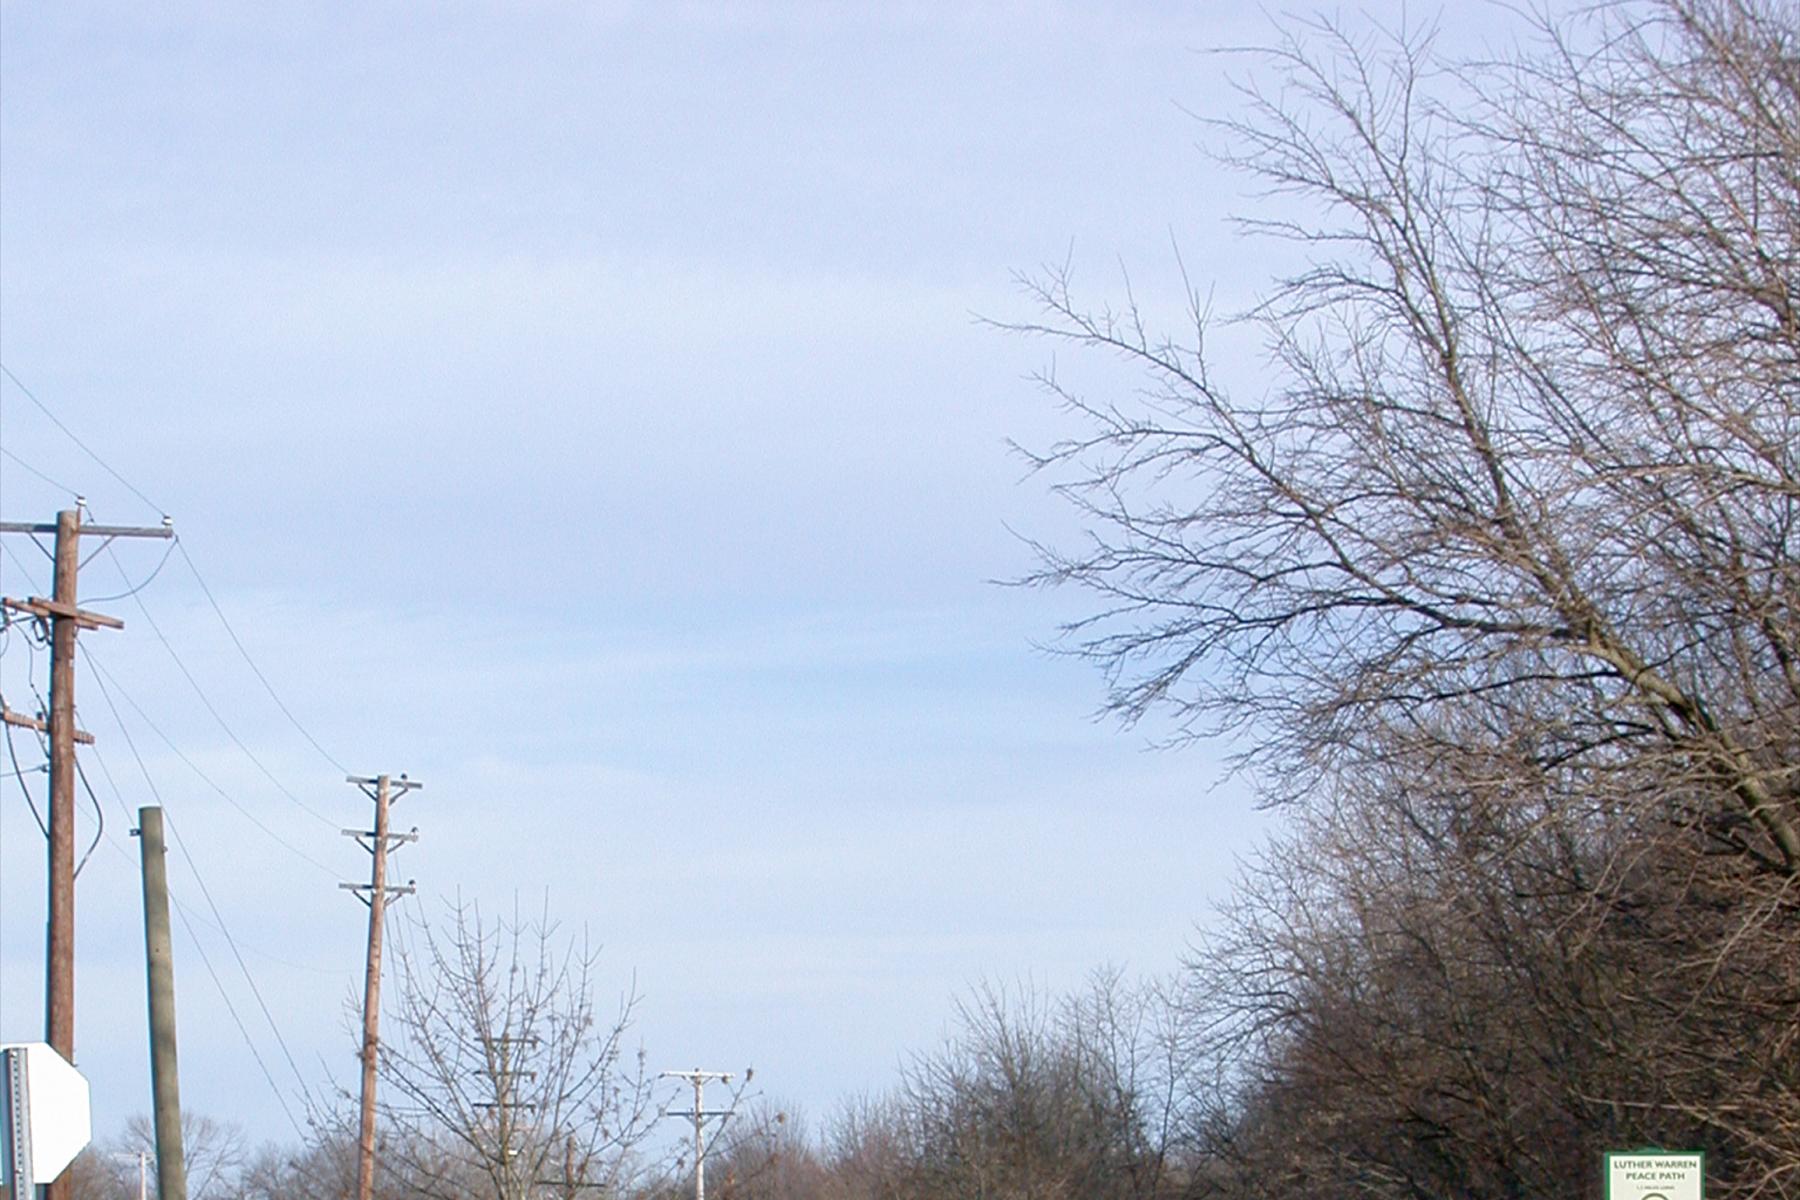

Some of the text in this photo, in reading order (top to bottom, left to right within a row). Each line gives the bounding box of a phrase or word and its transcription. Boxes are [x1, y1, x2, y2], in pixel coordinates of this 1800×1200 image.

[1613, 1160, 1698, 1169] LUTHER WARREN
[1625, 1172, 1686, 1180] PEACE PATH
